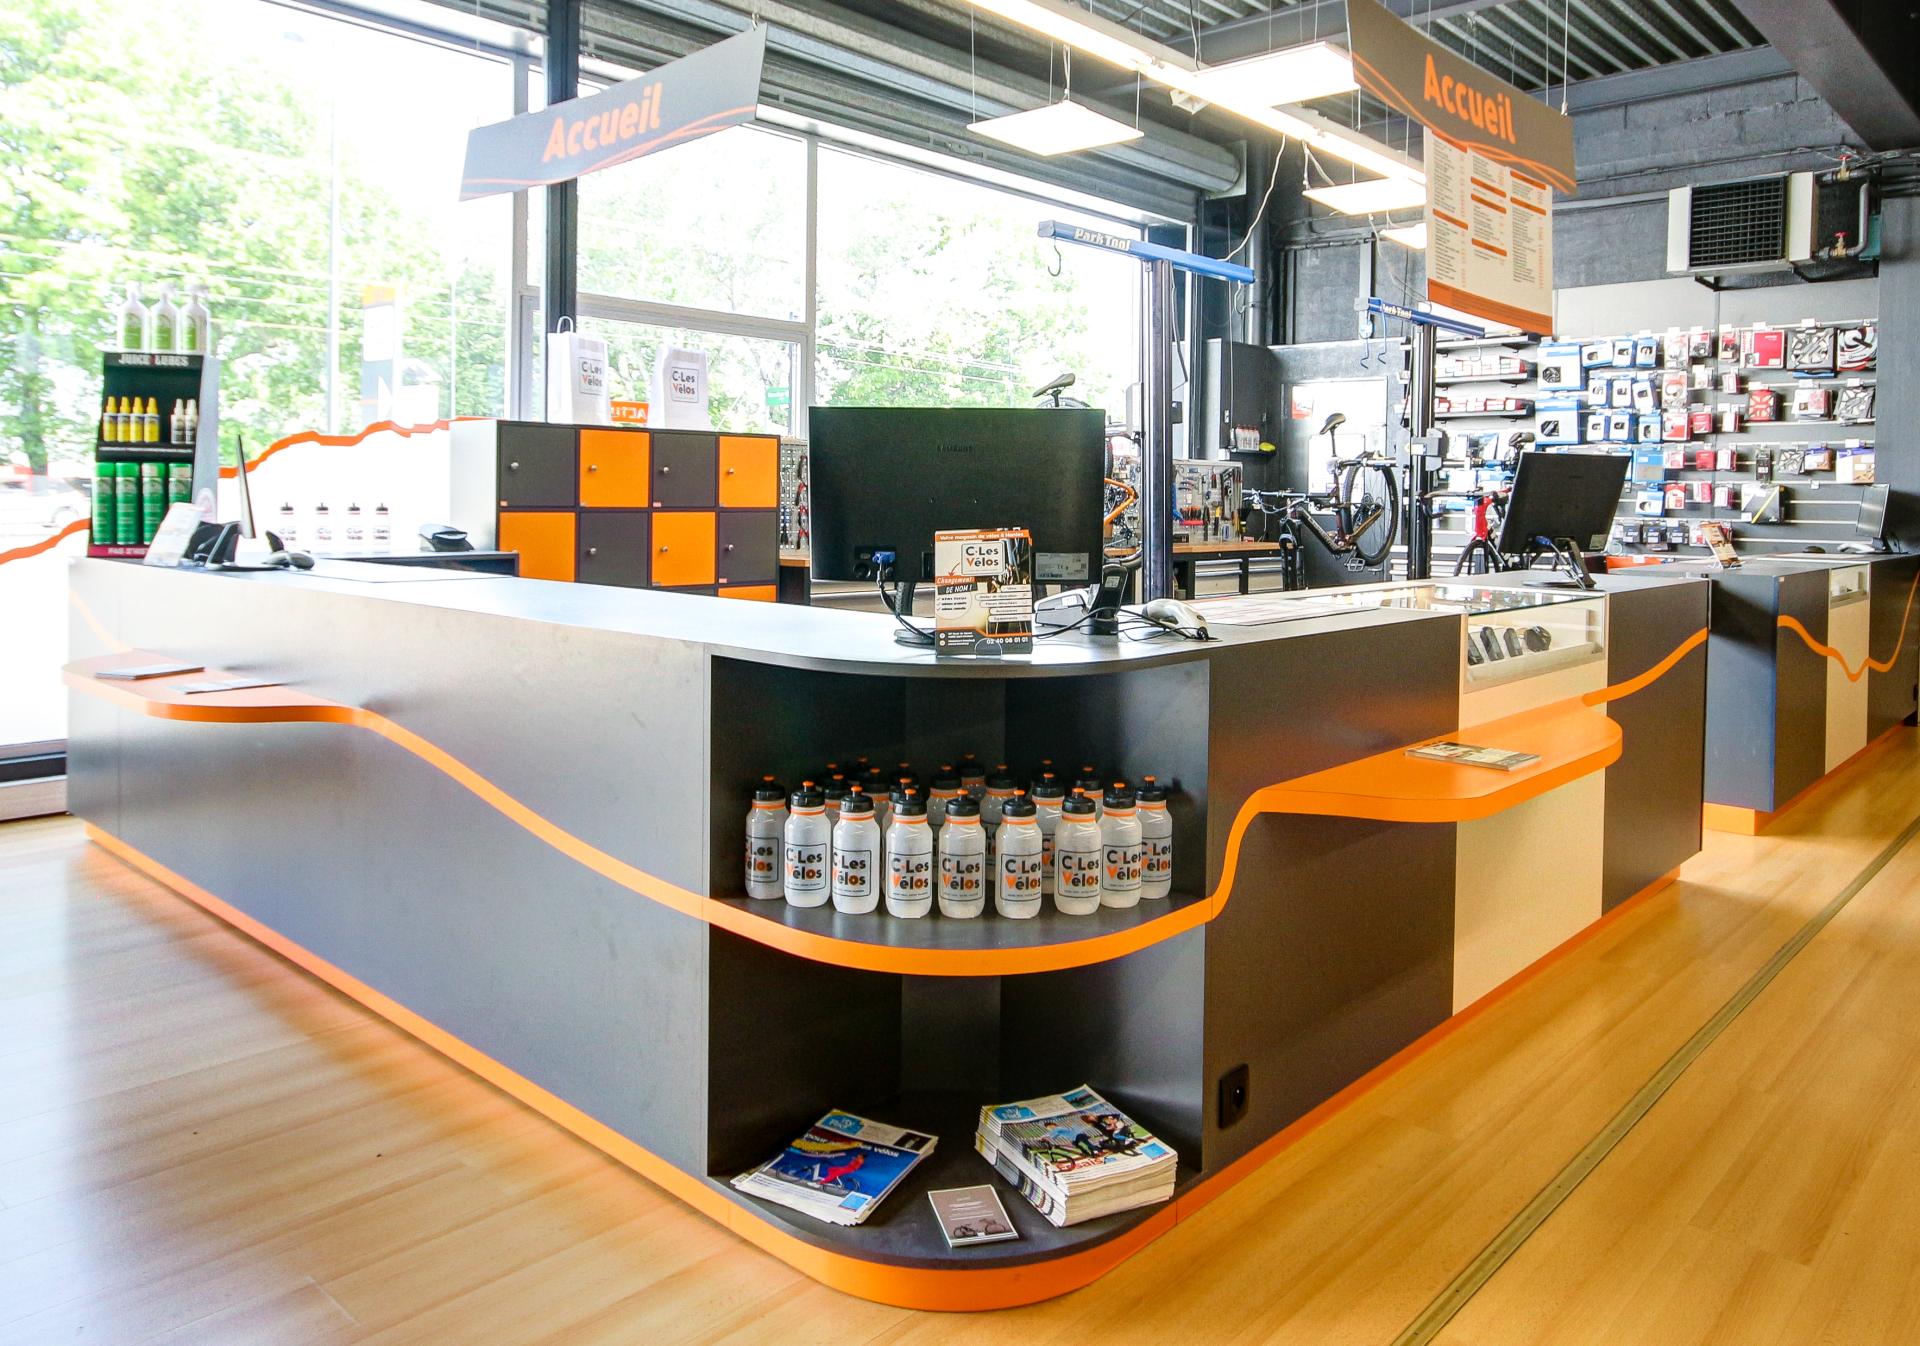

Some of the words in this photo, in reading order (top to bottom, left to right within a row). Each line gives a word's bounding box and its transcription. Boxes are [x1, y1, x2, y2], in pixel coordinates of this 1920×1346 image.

[1424, 53, 1516, 144] Accueil
[543, 82, 662, 163] Accueil
[1074, 227, 1103, 244] Park
[1104, 234, 1131, 251] Tool
[673, 383, 695, 395] Vélos
[966, 557, 998, 567] Vélos
[787, 863, 823, 880] Vélos
[1062, 871, 1099, 887] Vélos
[1106, 865, 1141, 881] Vélos
[891, 874, 928, 889] Vélos
[942, 873, 980, 890] Vélos
[1005, 874, 1041, 890] Vélos
